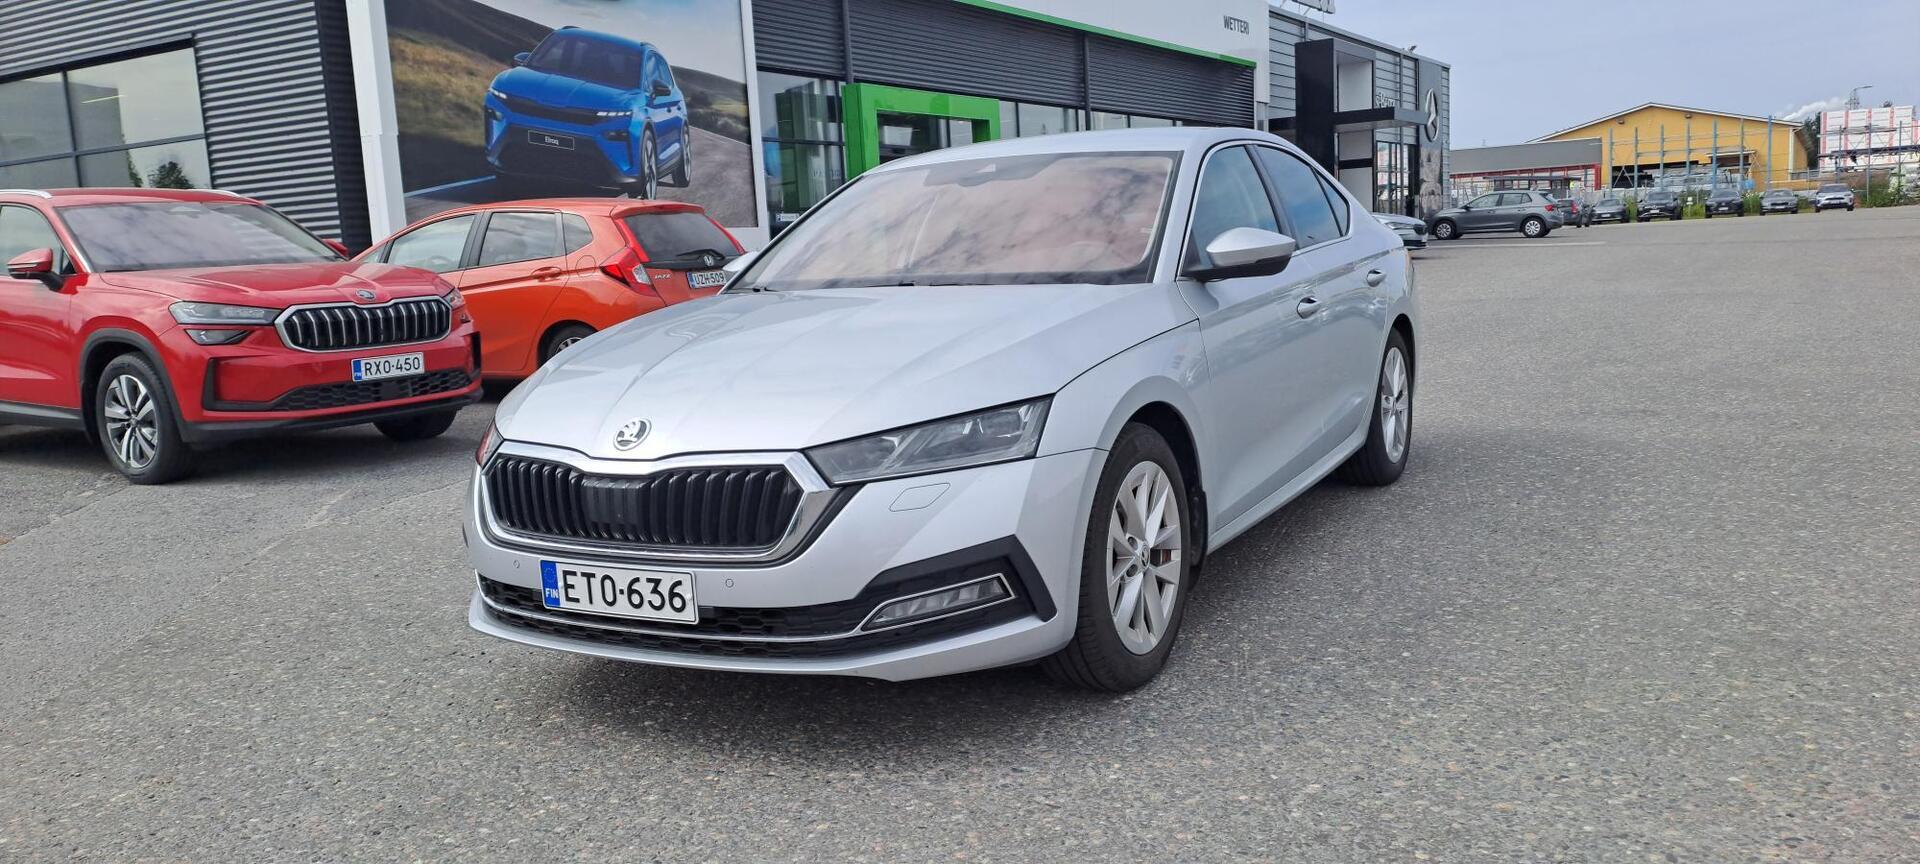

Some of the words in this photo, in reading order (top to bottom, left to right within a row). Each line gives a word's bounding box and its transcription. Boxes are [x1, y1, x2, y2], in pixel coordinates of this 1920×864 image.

[1223, 15, 1250, 35] WETTERI
[364, 357, 420, 376] RXO-450
[545, 588, 559, 598] FIN
[562, 569, 686, 613] ETO-636
